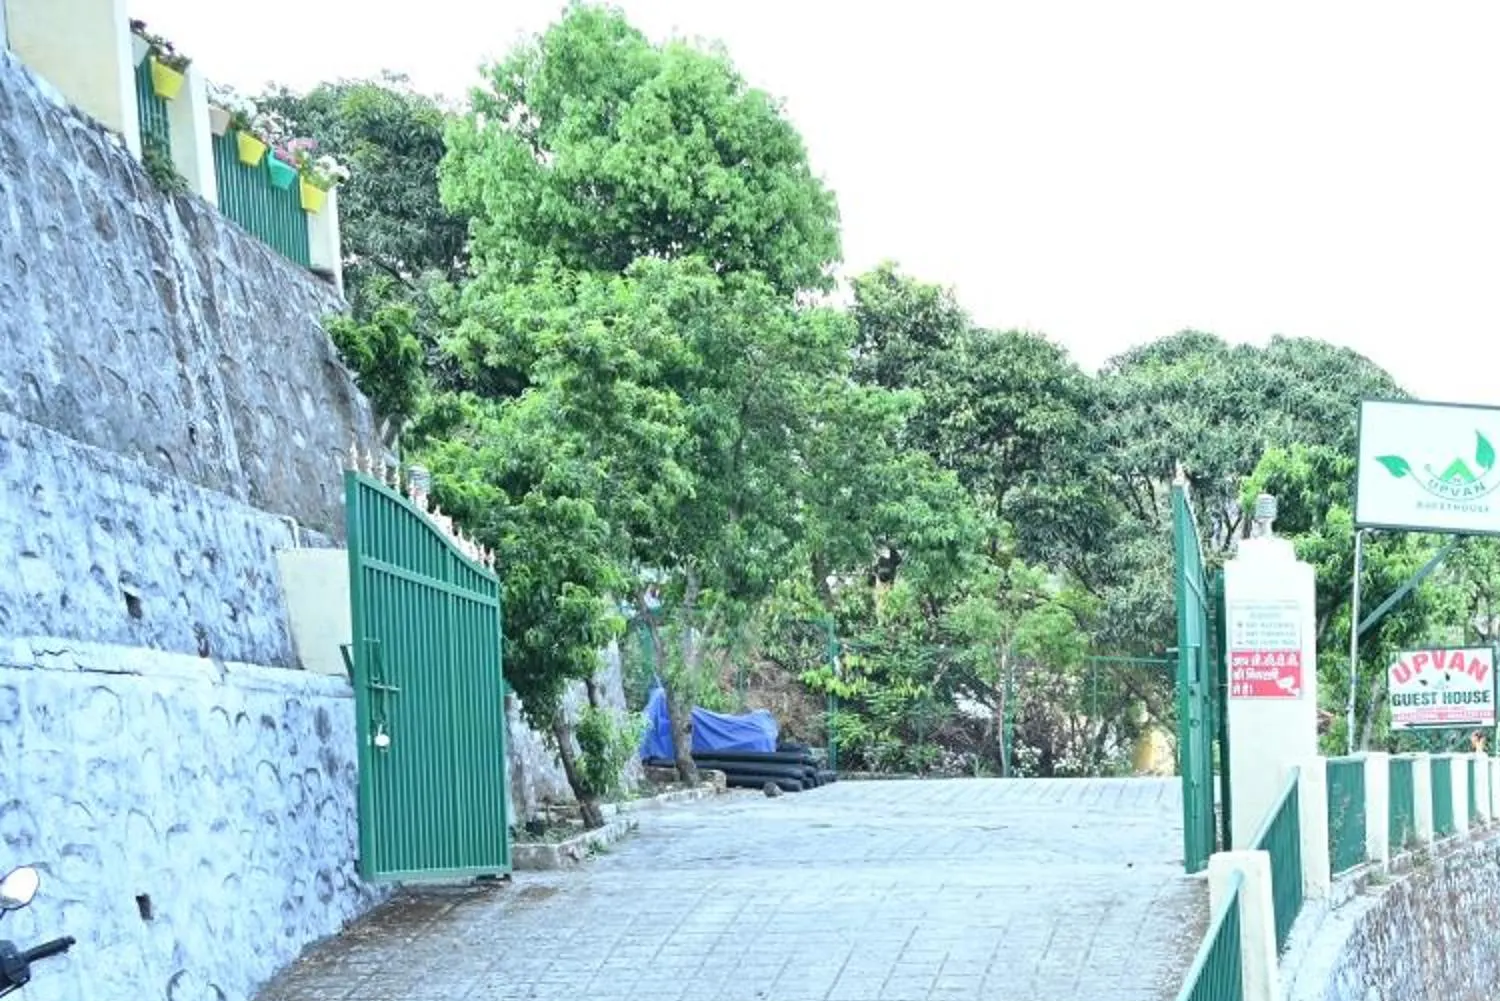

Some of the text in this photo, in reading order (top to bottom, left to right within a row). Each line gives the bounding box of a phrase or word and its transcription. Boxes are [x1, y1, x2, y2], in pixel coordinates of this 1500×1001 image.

[1391, 649, 1489, 685] UPVAN
[1392, 689, 1491, 707] GUEST HOUSE
